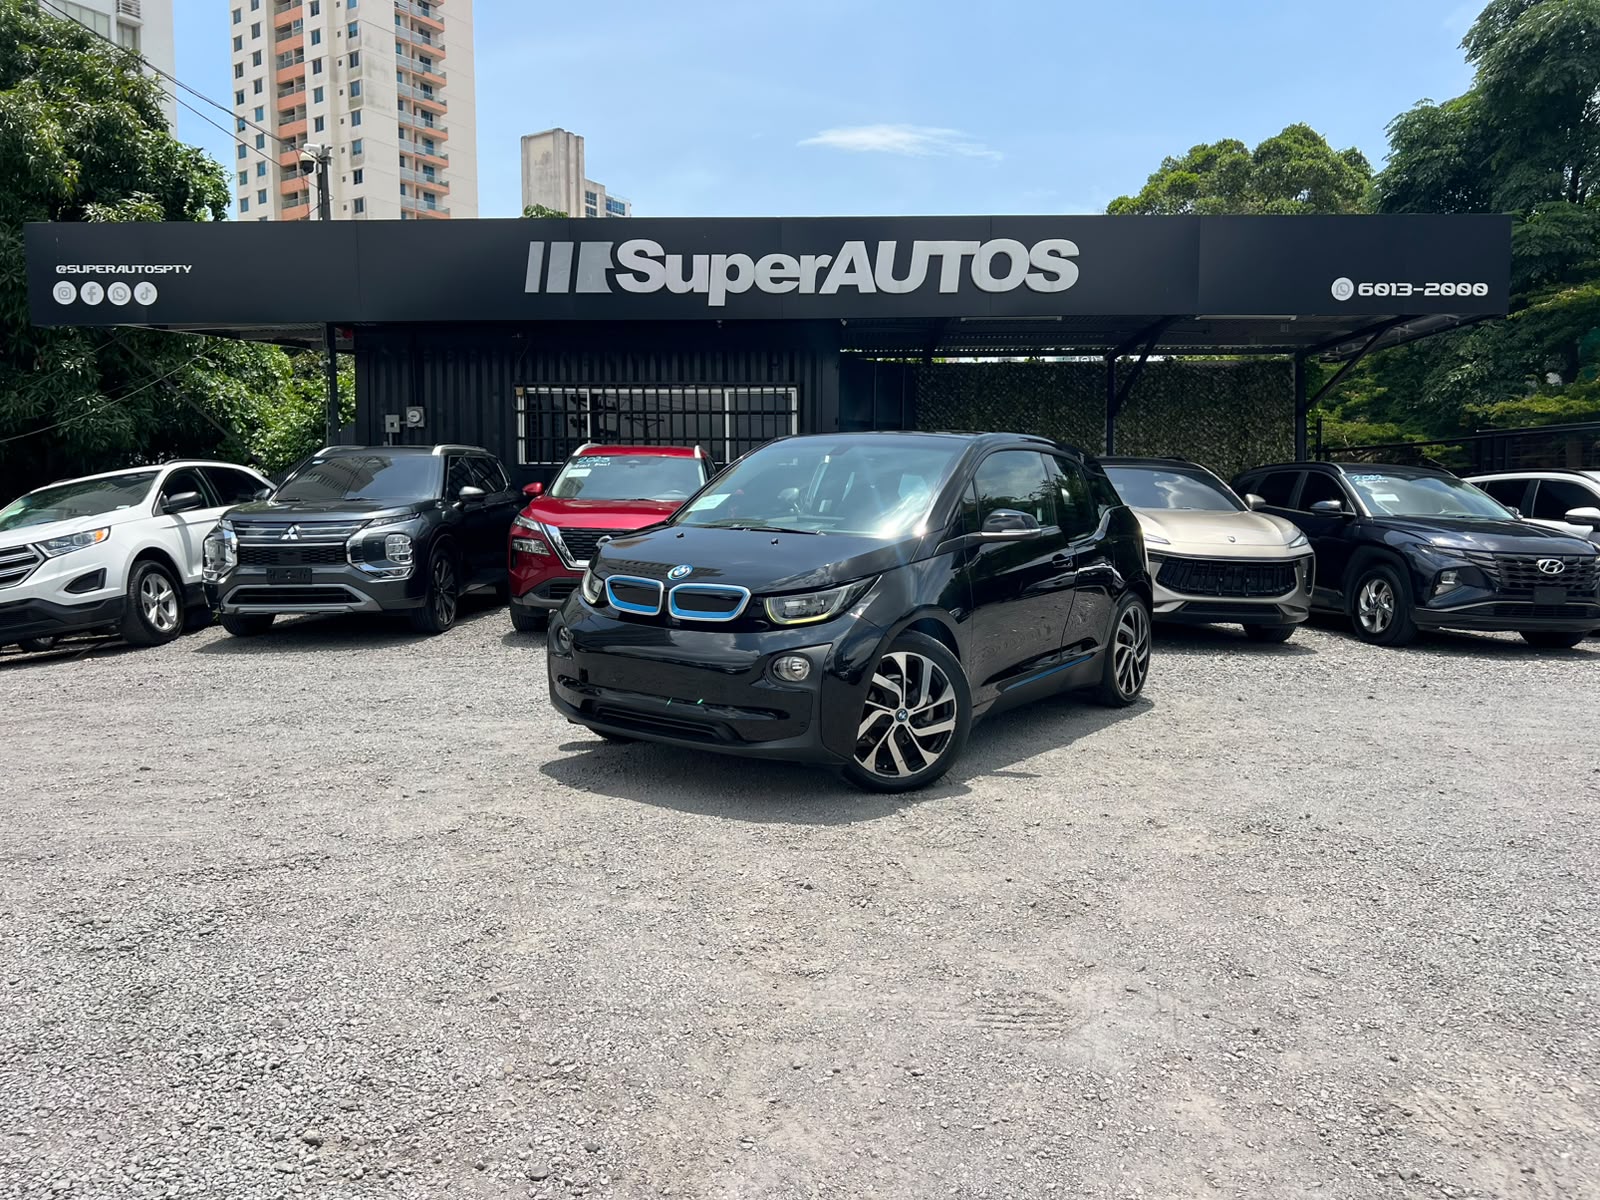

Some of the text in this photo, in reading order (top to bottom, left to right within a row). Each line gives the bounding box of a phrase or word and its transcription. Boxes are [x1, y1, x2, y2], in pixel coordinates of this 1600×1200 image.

[55, 264, 192, 274] @SUPERAUTOSPTY
[614, 238, 1080, 307] SuperAUTOS
[1357, 282, 1489, 297] 6013-2000
